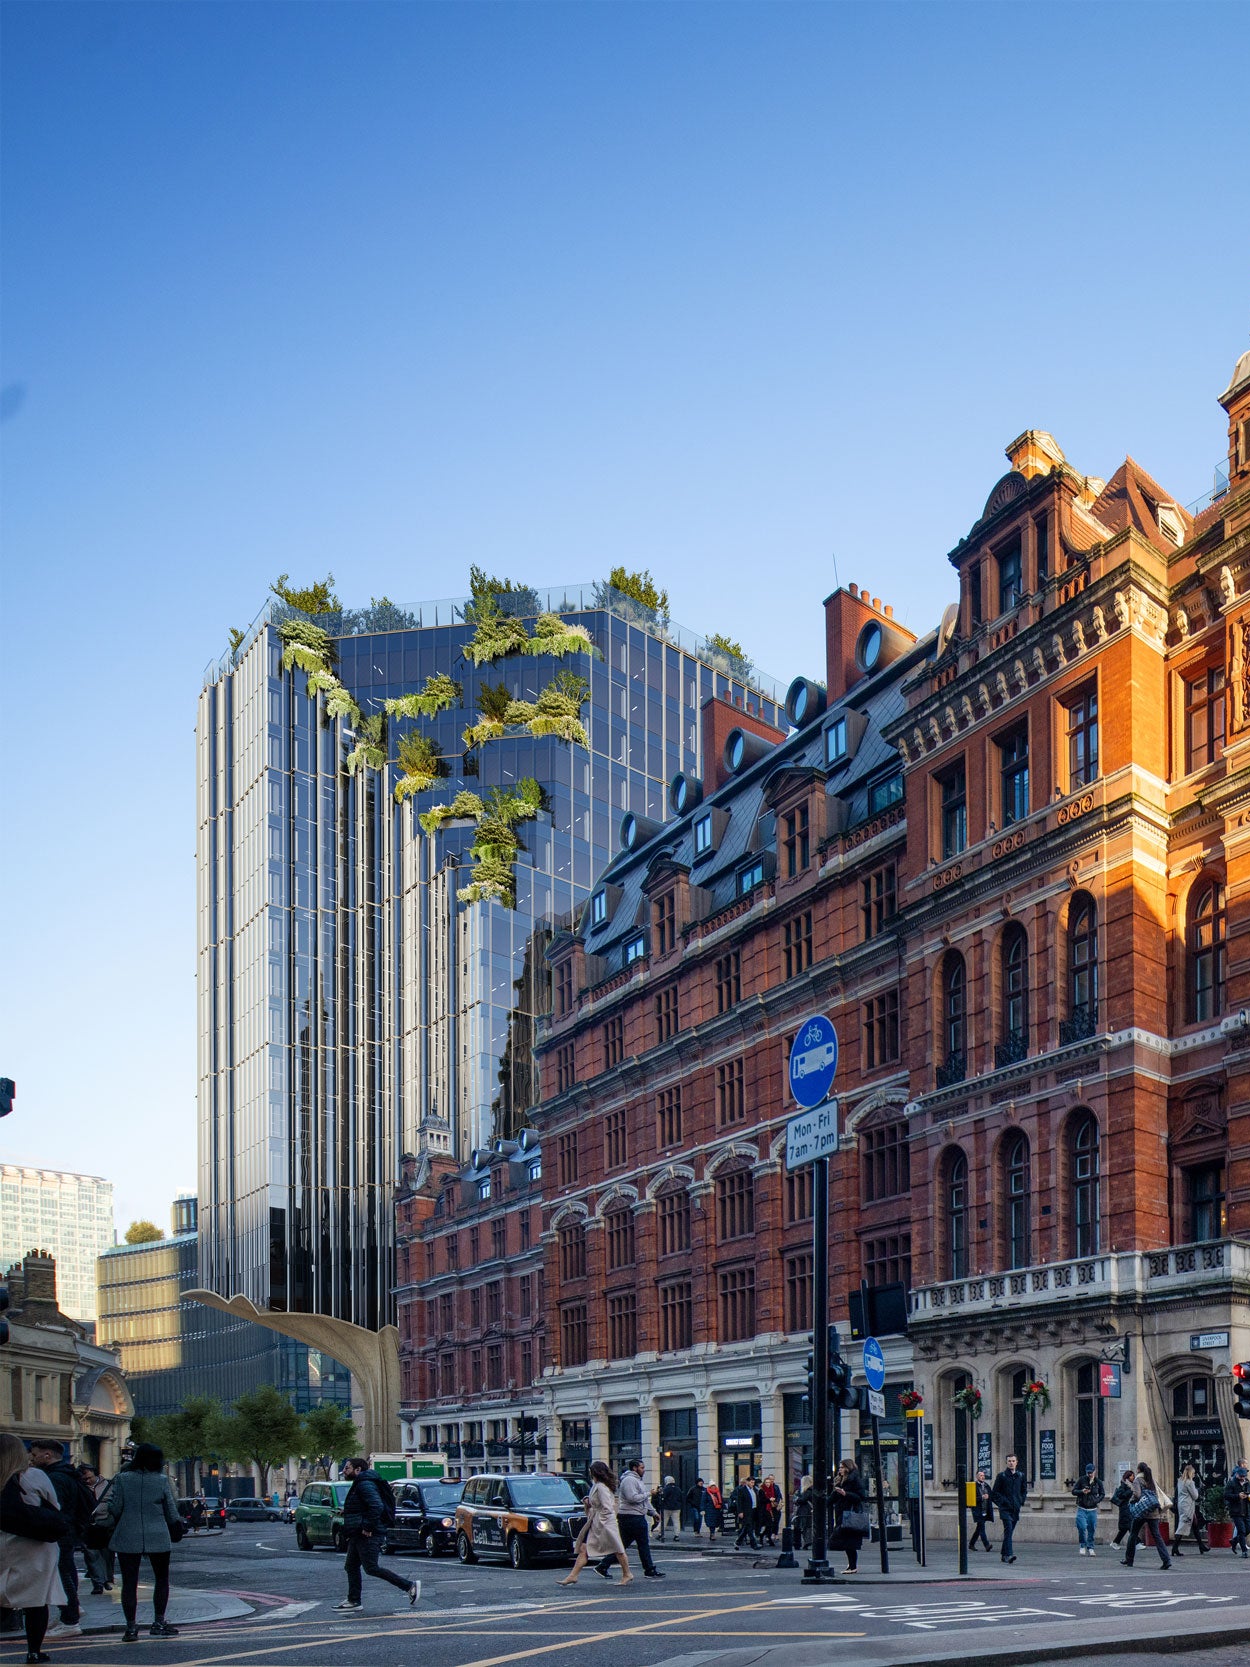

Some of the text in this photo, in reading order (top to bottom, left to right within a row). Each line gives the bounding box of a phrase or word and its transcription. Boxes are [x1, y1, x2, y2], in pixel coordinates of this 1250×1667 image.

[794, 1123, 812, 1140] Mon
[818, 1111, 830, 1129] Fri
[789, 1144, 808, 1160] 7am
[814, 1132, 835, 1150] 7pm
